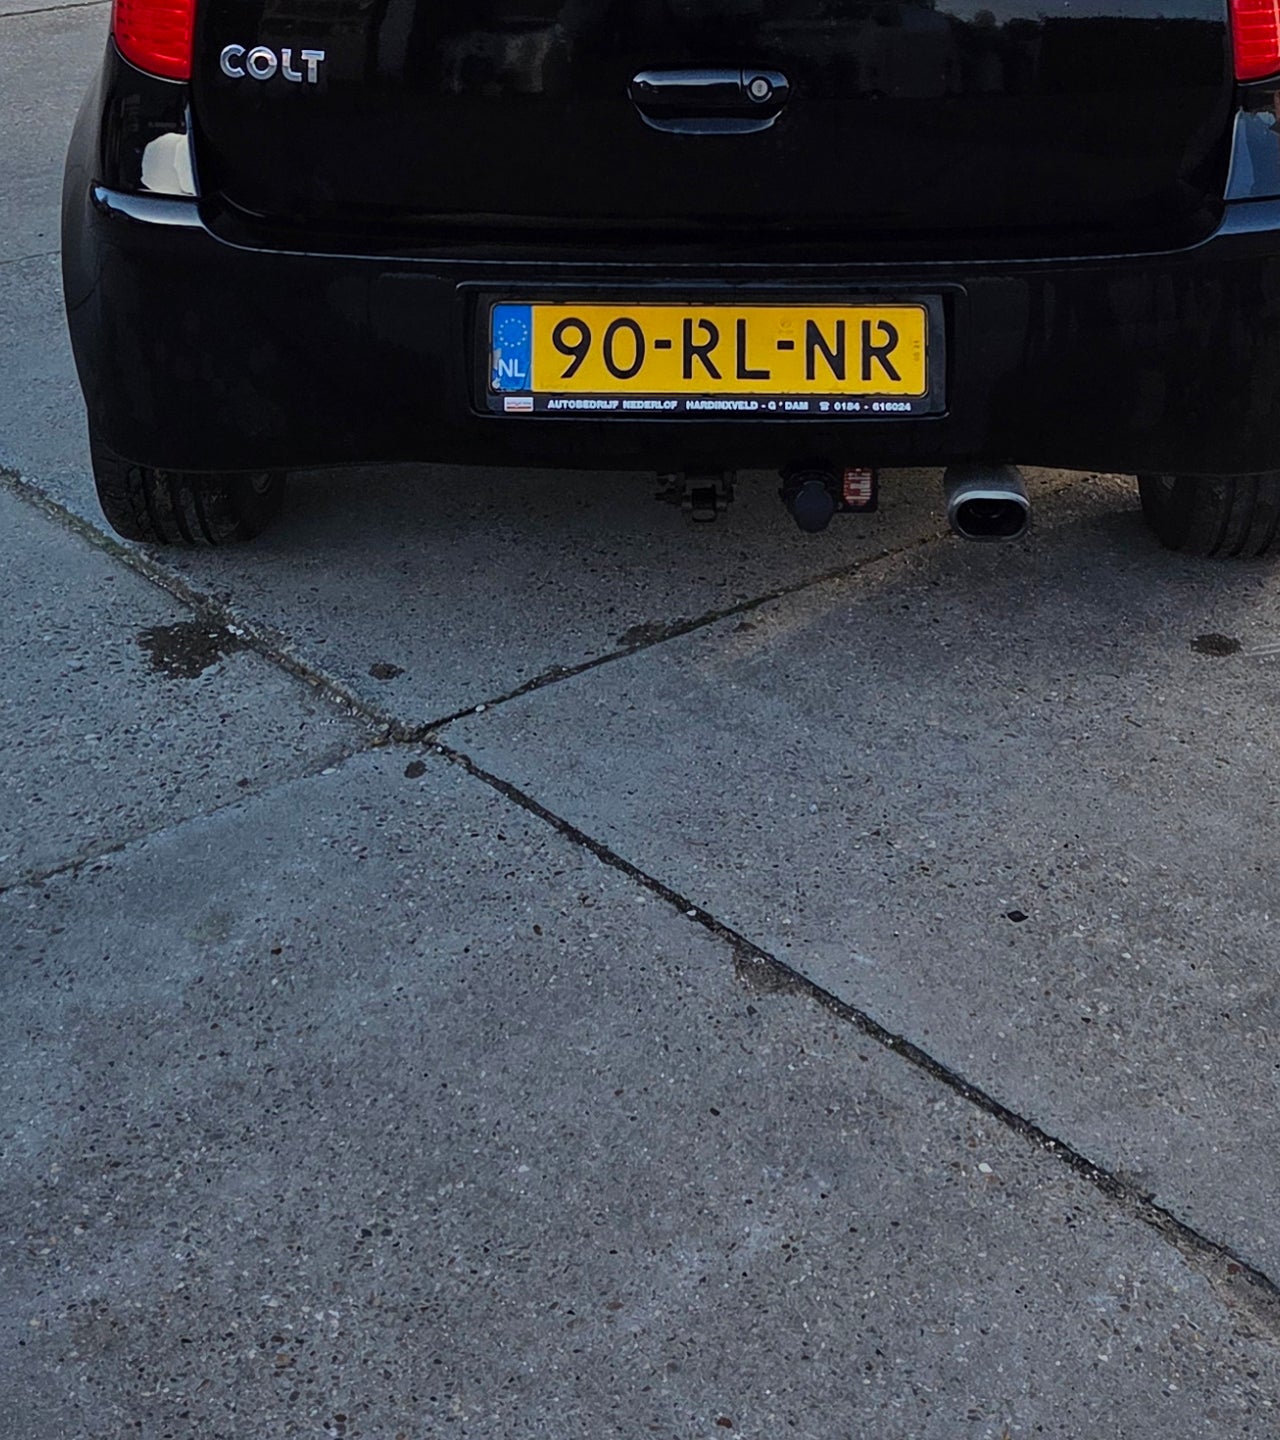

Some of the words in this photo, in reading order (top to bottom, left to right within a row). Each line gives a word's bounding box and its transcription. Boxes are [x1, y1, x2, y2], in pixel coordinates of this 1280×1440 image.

[220, 44, 325, 84] COLT
[552, 317, 902, 381] 90-RL-NR
[498, 358, 526, 378] NL
[547, 399, 619, 410] AUTOBEDRIJF
